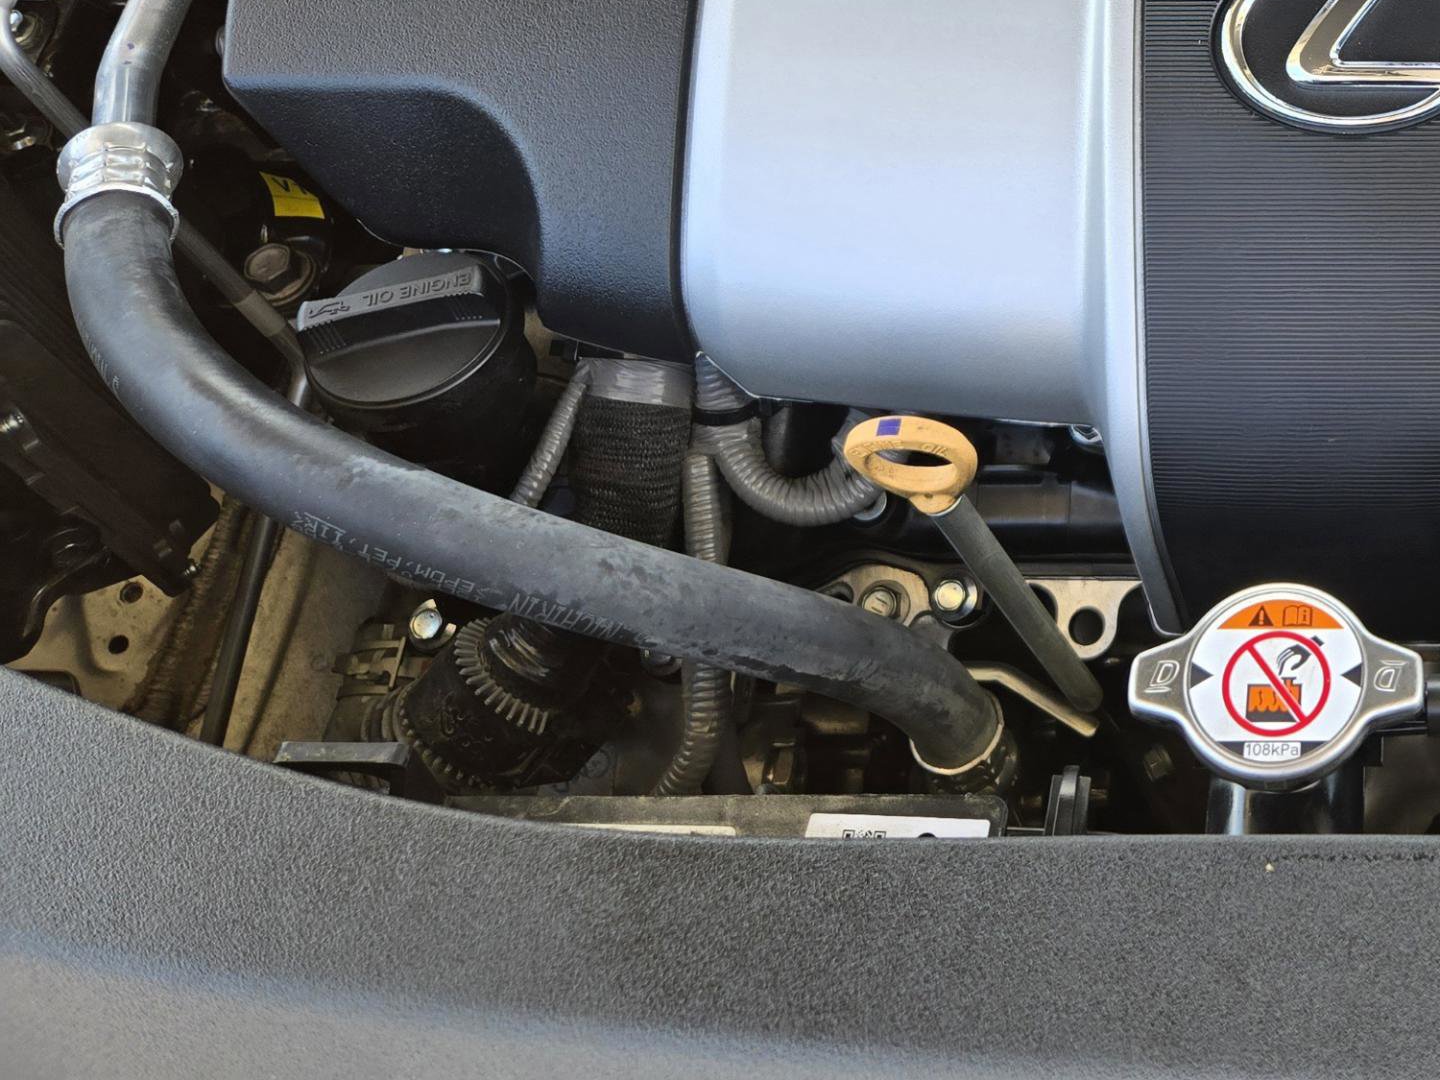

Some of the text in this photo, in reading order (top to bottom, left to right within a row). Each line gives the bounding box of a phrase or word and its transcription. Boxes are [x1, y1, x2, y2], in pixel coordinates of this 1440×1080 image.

[362, 272, 472, 307] ENGINE OIL
[1246, 743, 1299, 757] 108kPa
